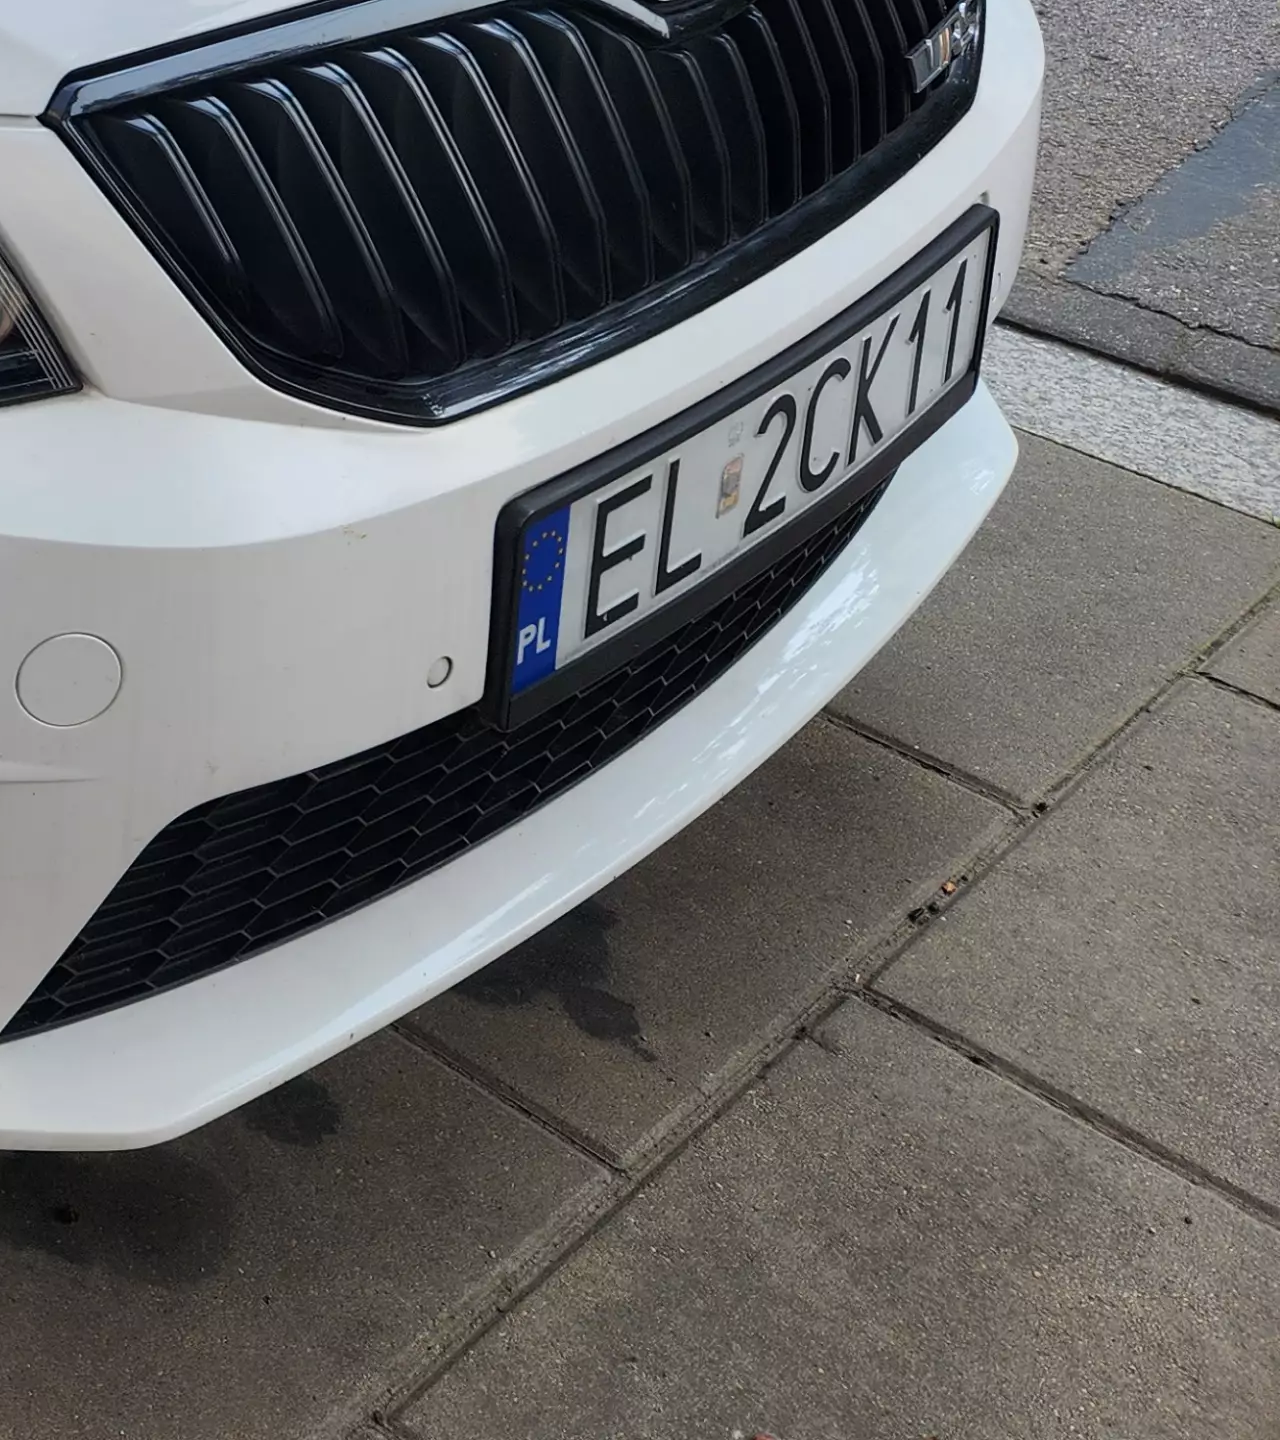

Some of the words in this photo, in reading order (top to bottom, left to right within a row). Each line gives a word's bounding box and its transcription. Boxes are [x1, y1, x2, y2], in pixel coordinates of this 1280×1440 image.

[583, 457, 703, 641] EL
[742, 258, 969, 539] 2CK11
[516, 616, 552, 665] PL
